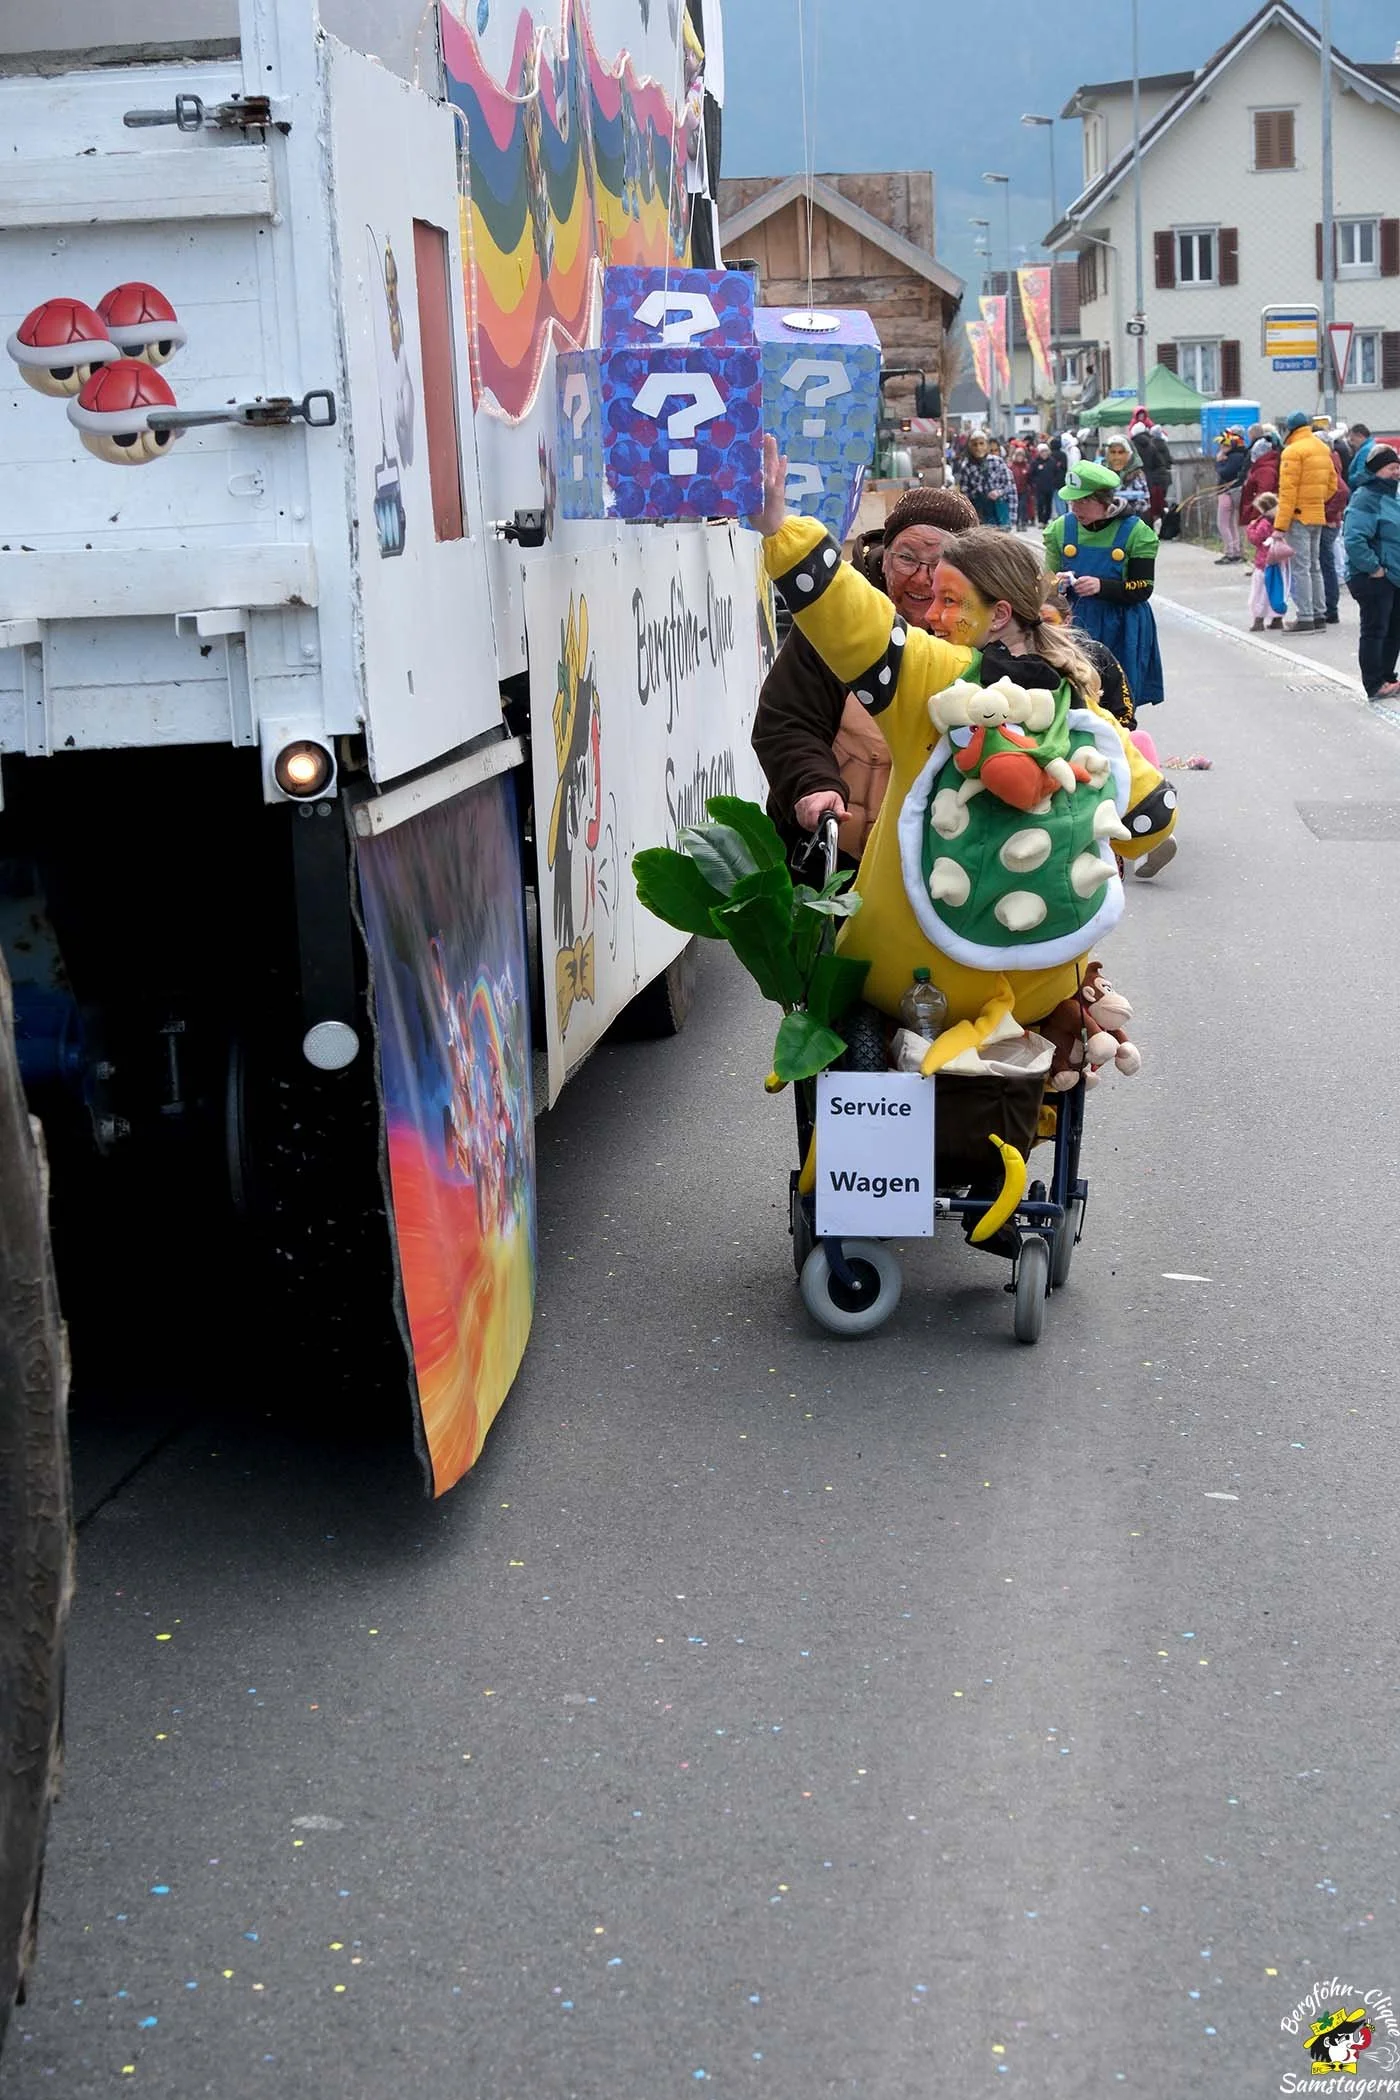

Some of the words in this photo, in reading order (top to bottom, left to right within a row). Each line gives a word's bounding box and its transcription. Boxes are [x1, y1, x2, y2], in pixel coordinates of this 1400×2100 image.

[632, 372, 727, 476] ?
[1069, 473, 1077, 486] L
[830, 1097, 912, 1117] Service
[830, 1171, 920, 1198] Wagen
